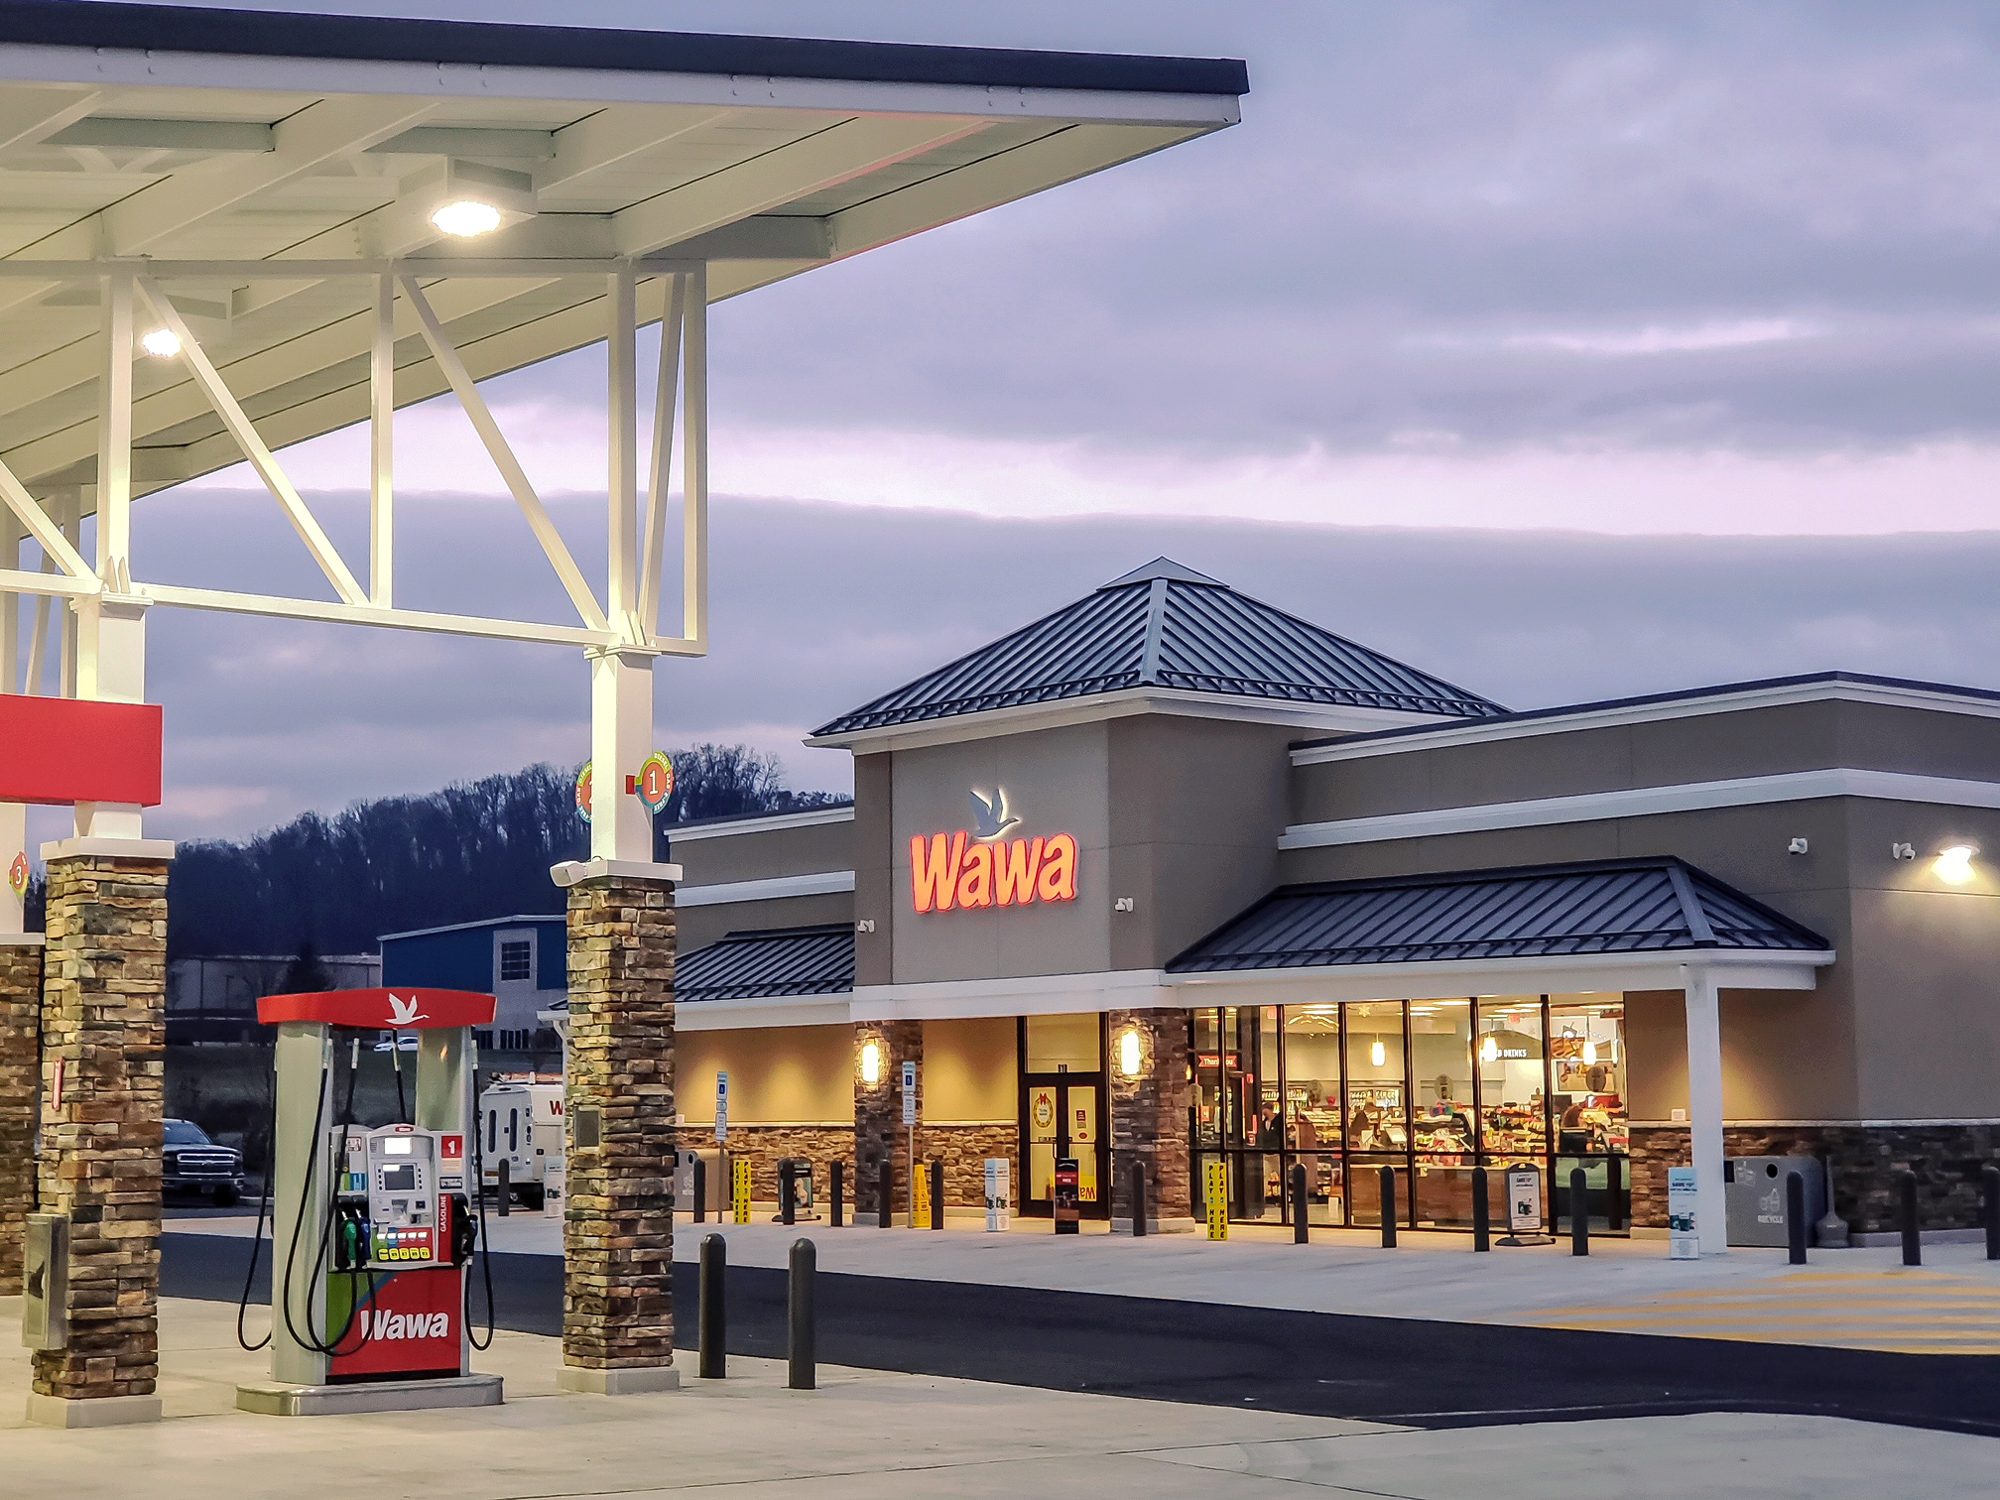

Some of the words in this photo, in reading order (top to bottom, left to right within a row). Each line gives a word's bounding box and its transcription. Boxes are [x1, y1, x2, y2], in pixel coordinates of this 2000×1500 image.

[649, 770, 659, 795] 1
[15, 865, 22, 885] 3
[911, 831, 1077, 914] Wawa
[1503, 1049, 1527, 1058] DRINKS
[447, 1140, 456, 1155] 1
[360, 1309, 449, 1341] Wawa
